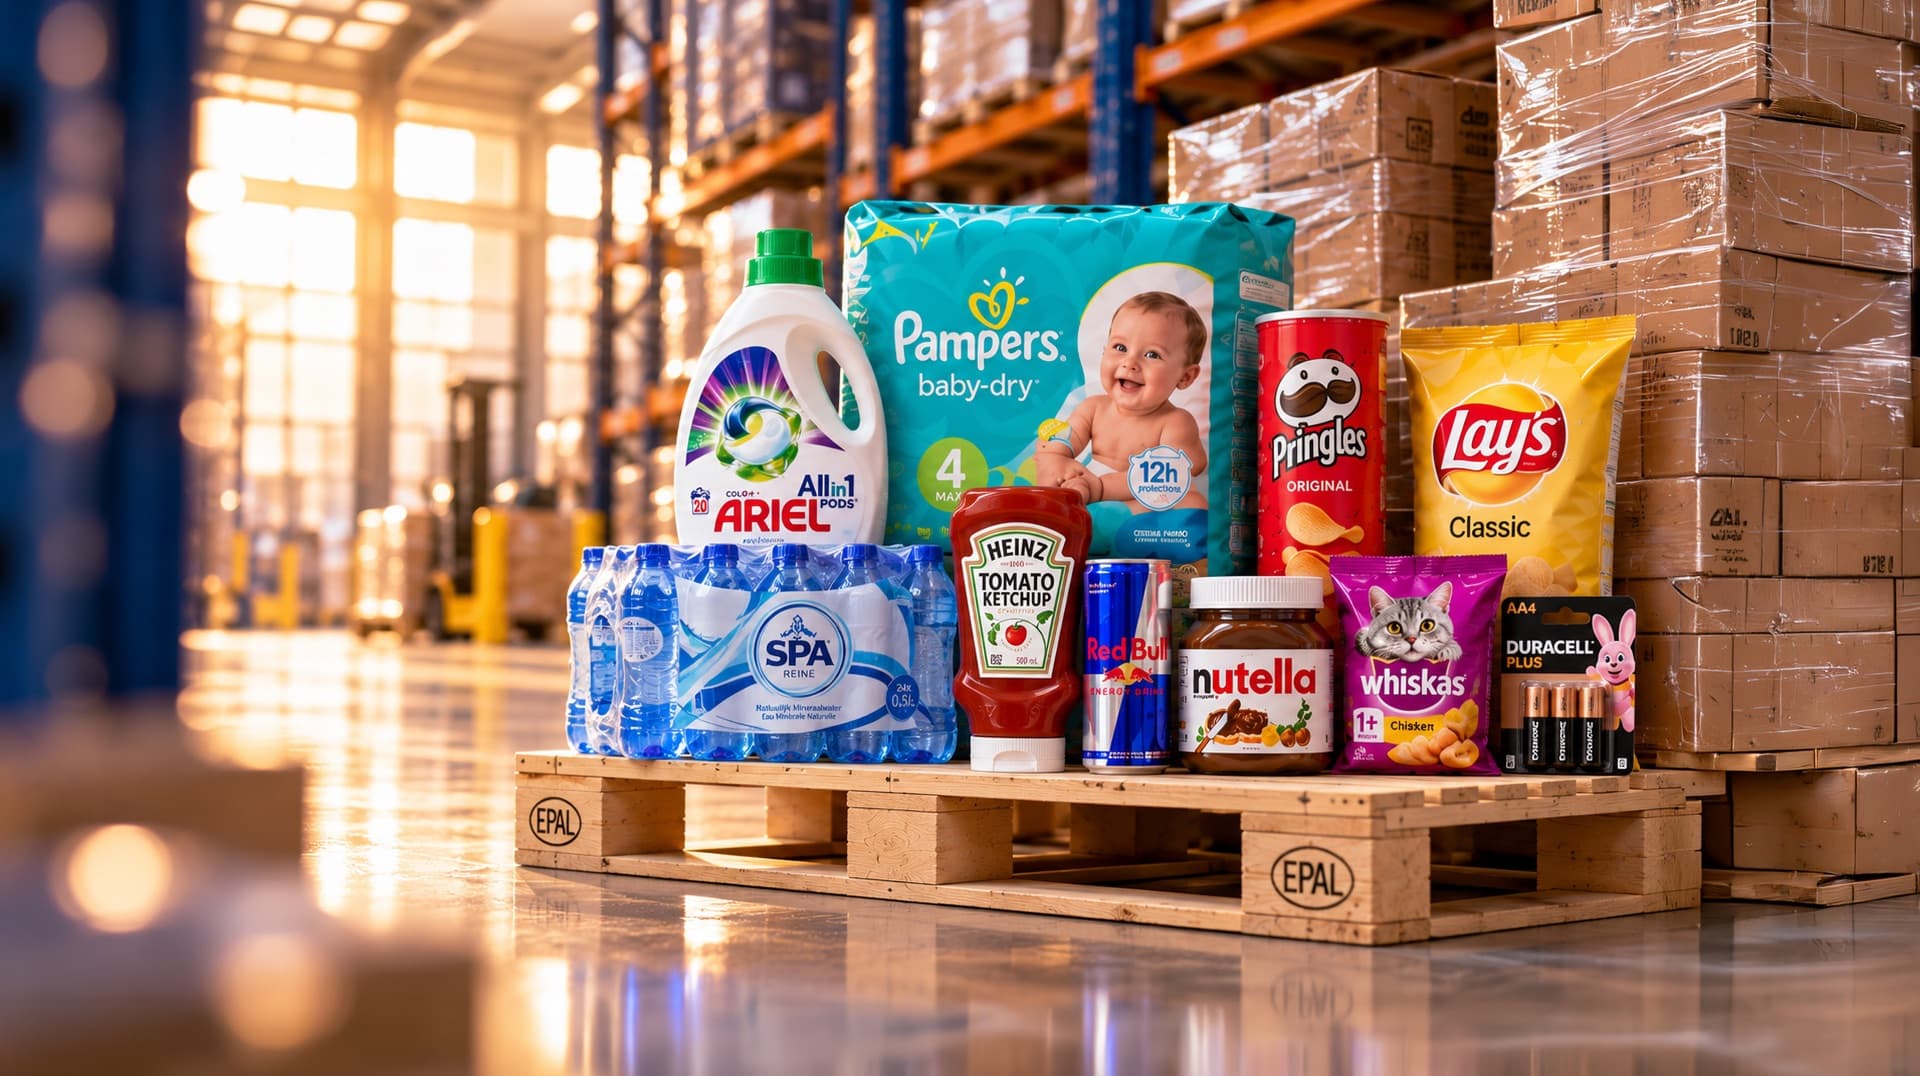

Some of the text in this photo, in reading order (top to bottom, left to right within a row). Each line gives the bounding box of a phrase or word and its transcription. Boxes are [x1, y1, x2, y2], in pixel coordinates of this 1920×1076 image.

[894, 310, 1060, 371] Pampers
[918, 373, 1033, 402] baby-dry
[1272, 415, 1367, 482] Pringles
[1441, 410, 1557, 475] Lay's
[936, 448, 966, 489] 4
[1139, 460, 1178, 483] 12h
[1286, 480, 1353, 492] ORIGINAL
[694, 499, 707, 513] 20
[714, 499, 831, 532] ARIEL
[820, 499, 854, 509] PODS
[1449, 515, 1531, 538] Classic
[987, 537, 1049, 561] HEINZ
[978, 573, 1055, 591] TOMATO
[983, 592, 1052, 607] KETCHUP
[1507, 602, 1536, 614] AA4
[766, 639, 835, 667] SPA
[1087, 637, 1168, 661] Red Bull
[1506, 640, 1593, 655] DURACELL
[783, 669, 816, 678] REINE
[1506, 657, 1543, 668] PLUS
[1193, 657, 1317, 695] nutella
[1360, 668, 1465, 696] whiskas
[1356, 712, 1378, 733] 1+
[536, 808, 575, 836] EPAL
[1283, 860, 1344, 896] EPAL
